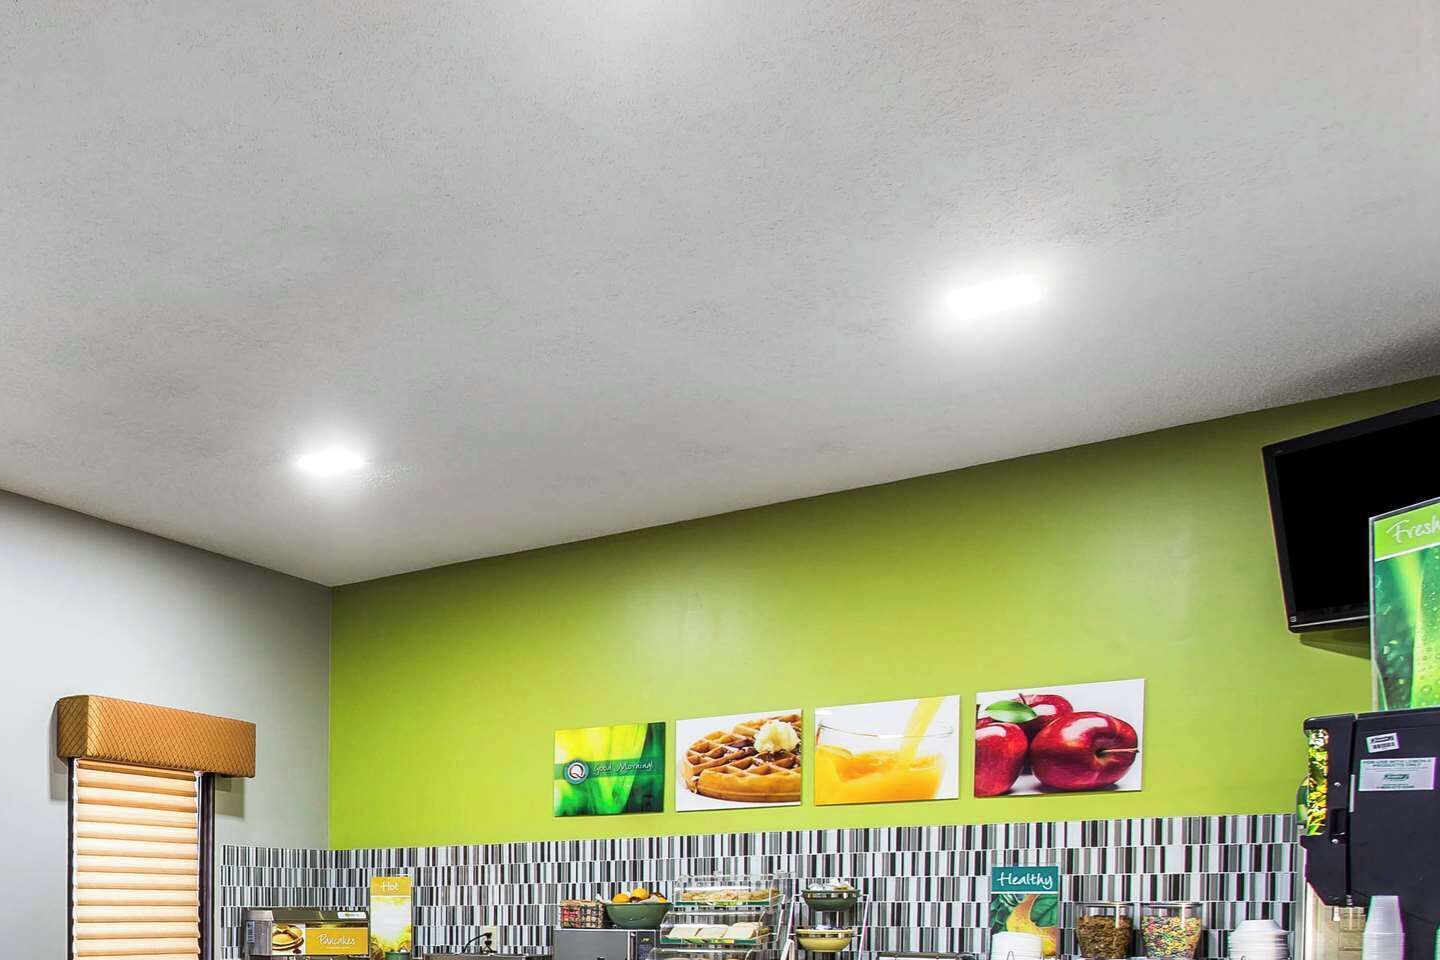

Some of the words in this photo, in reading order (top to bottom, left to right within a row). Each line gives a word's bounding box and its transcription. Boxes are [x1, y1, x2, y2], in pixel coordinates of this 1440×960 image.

[381, 881, 400, 891] Hot
[997, 871, 1054, 890] Healthy
[318, 934, 357, 946] Pancakes
